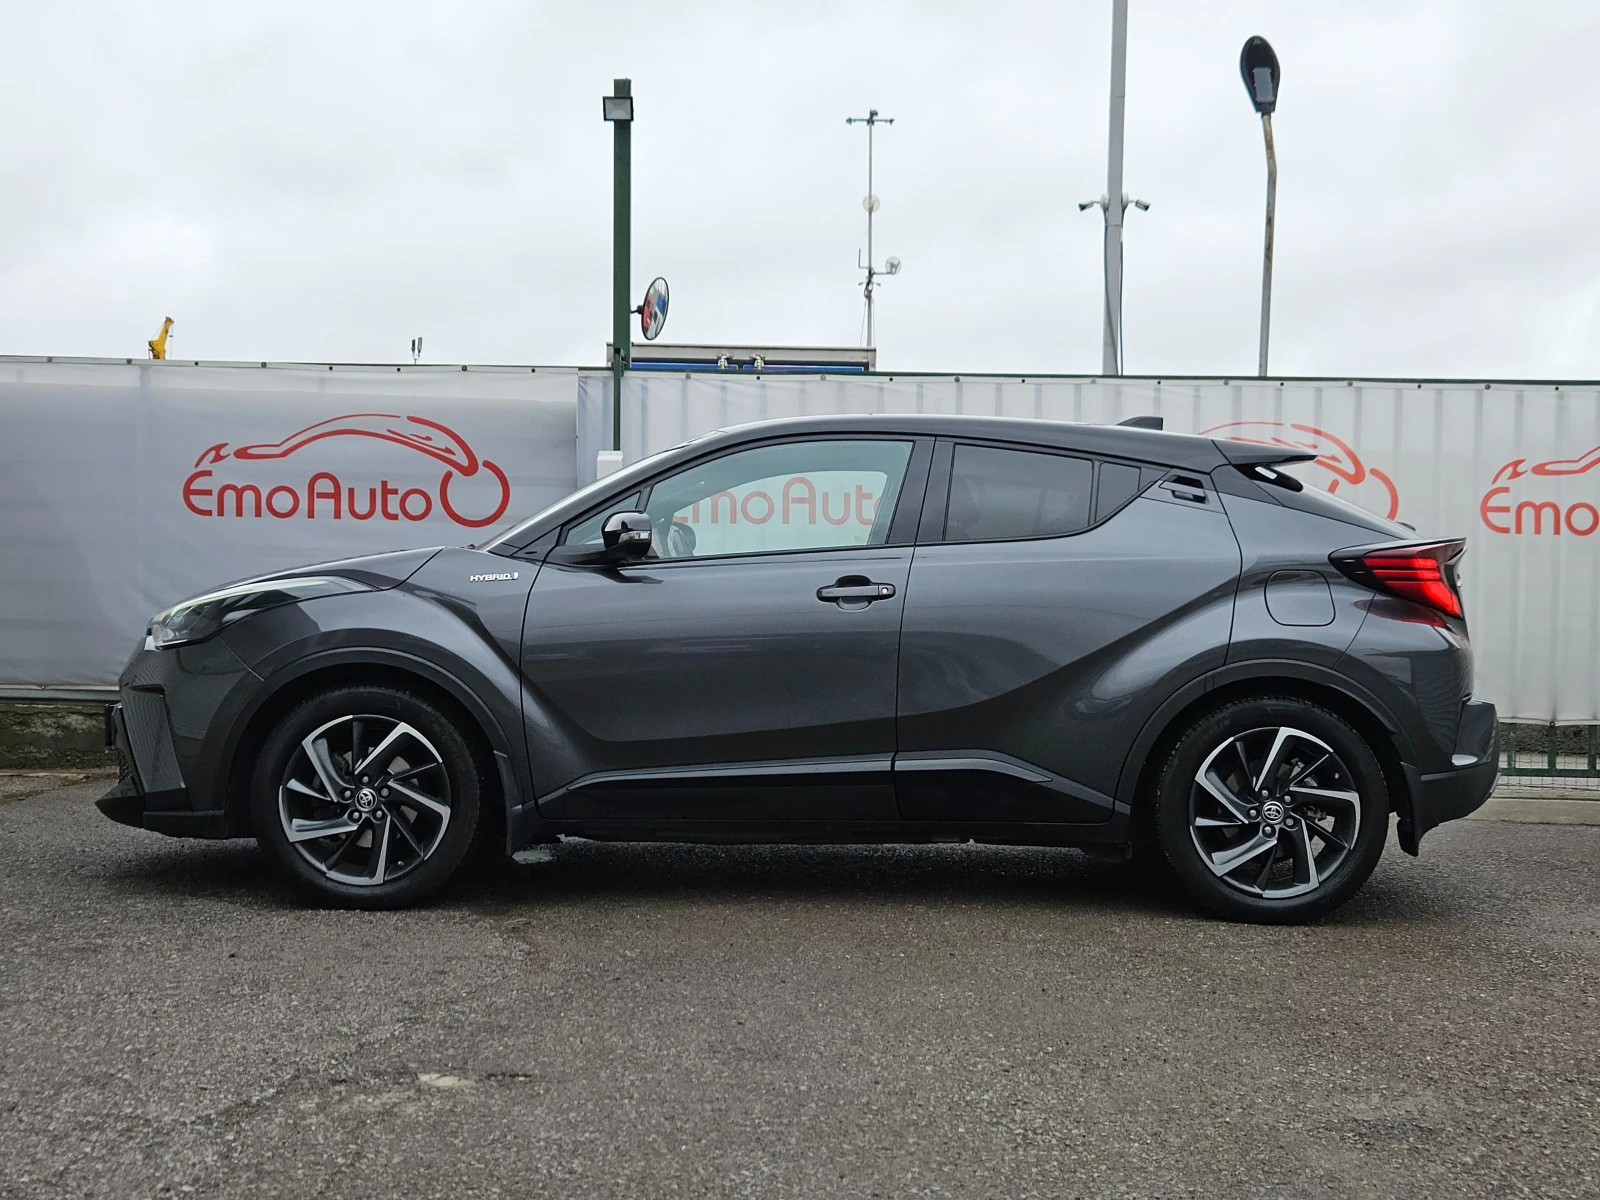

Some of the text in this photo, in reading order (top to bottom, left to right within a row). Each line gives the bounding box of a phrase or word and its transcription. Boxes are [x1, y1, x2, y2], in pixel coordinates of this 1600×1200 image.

[182, 470, 433, 521] EmoAuto
[673, 476, 880, 526] moAut
[470, 573, 511, 582] HYBRID
